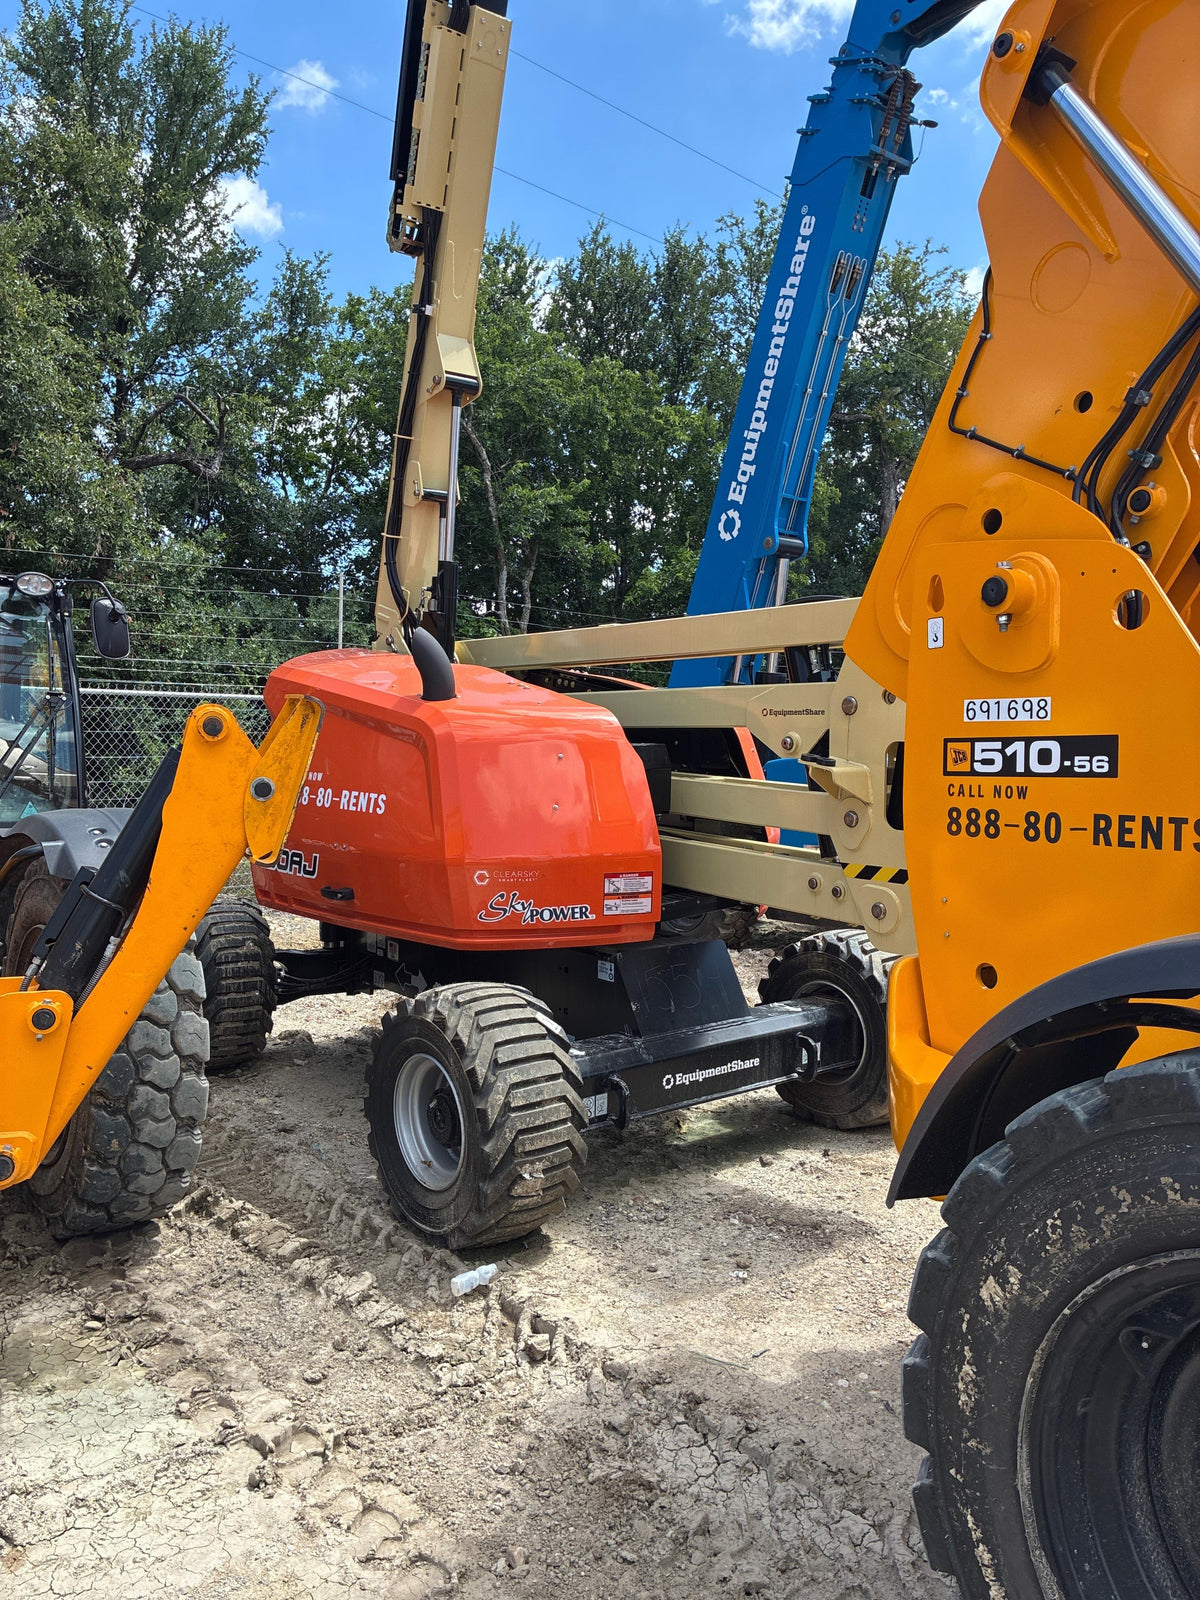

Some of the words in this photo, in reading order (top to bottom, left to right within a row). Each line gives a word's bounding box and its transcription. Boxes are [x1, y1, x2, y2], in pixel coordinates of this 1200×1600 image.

[769, 708, 826, 717] EquipmentShare
[965, 698, 1049, 720] 691698
[952, 749, 968, 764] JCB
[308, 771, 323, 781] NOW
[947, 783, 985, 798] CALL
[993, 785, 1029, 800] NOW
[493, 870, 540, 878] CLEARSKY
[675, 1057, 760, 1085] EquipmentShare
